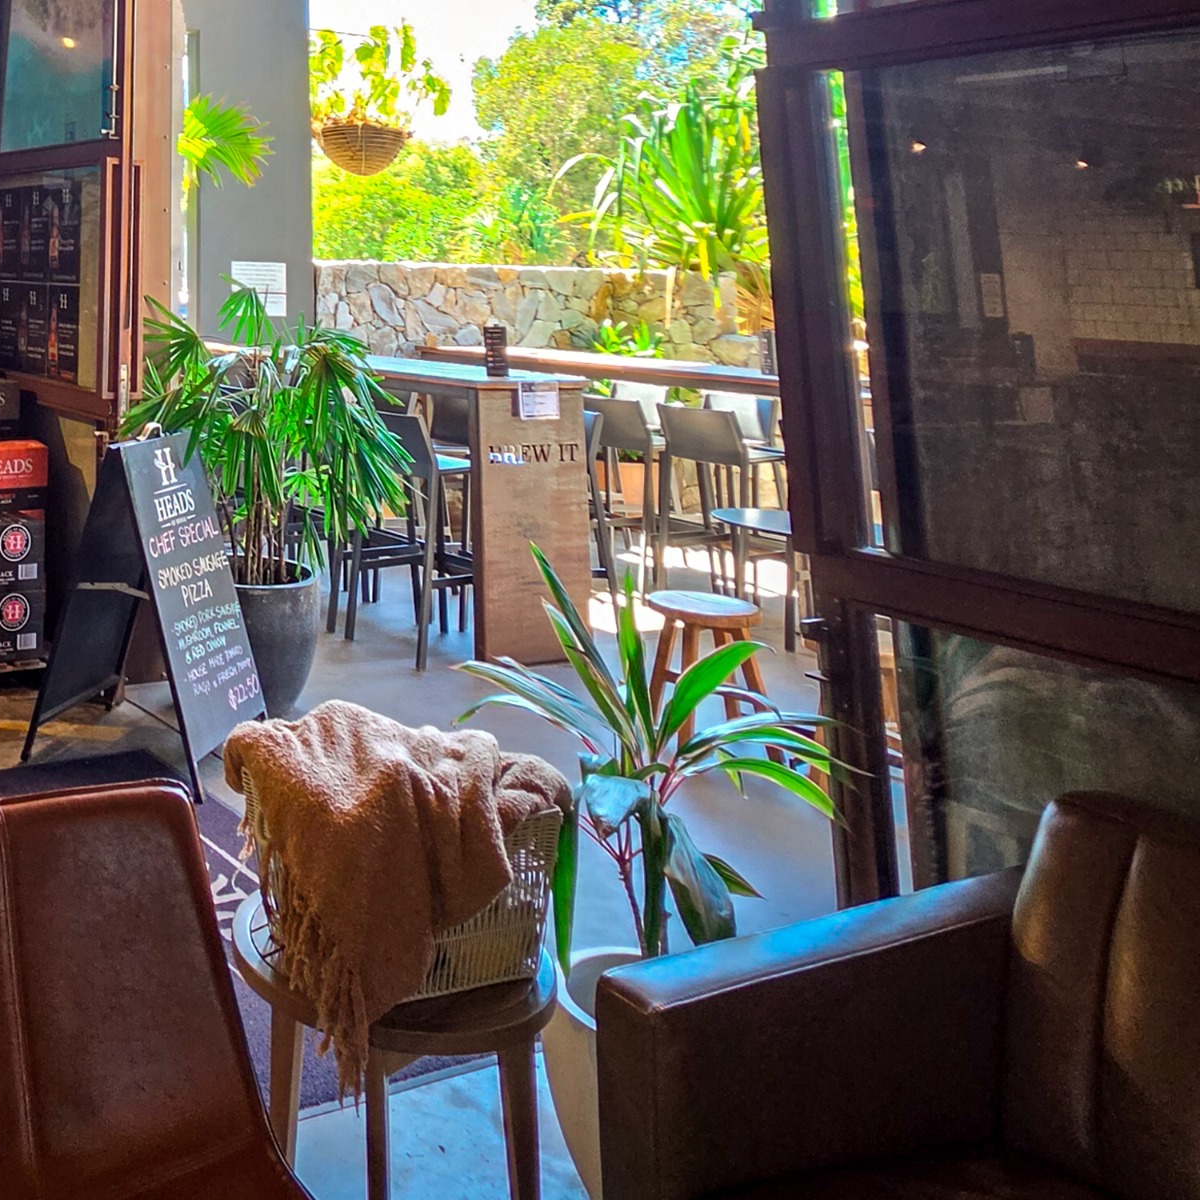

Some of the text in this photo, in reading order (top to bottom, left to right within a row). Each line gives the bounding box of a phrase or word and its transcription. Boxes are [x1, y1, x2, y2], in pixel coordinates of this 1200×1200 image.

[489, 443, 579, 464] BREW IT
[153, 489, 195, 522] HEADS
[149, 516, 219, 558] CHEF SPECIAL
[158, 550, 230, 590] SMOKED SAUSAGE
[181, 578, 213, 607] PIZZA
[191, 644, 206, 660] RED
[187, 662, 208, 682] HOUSE
